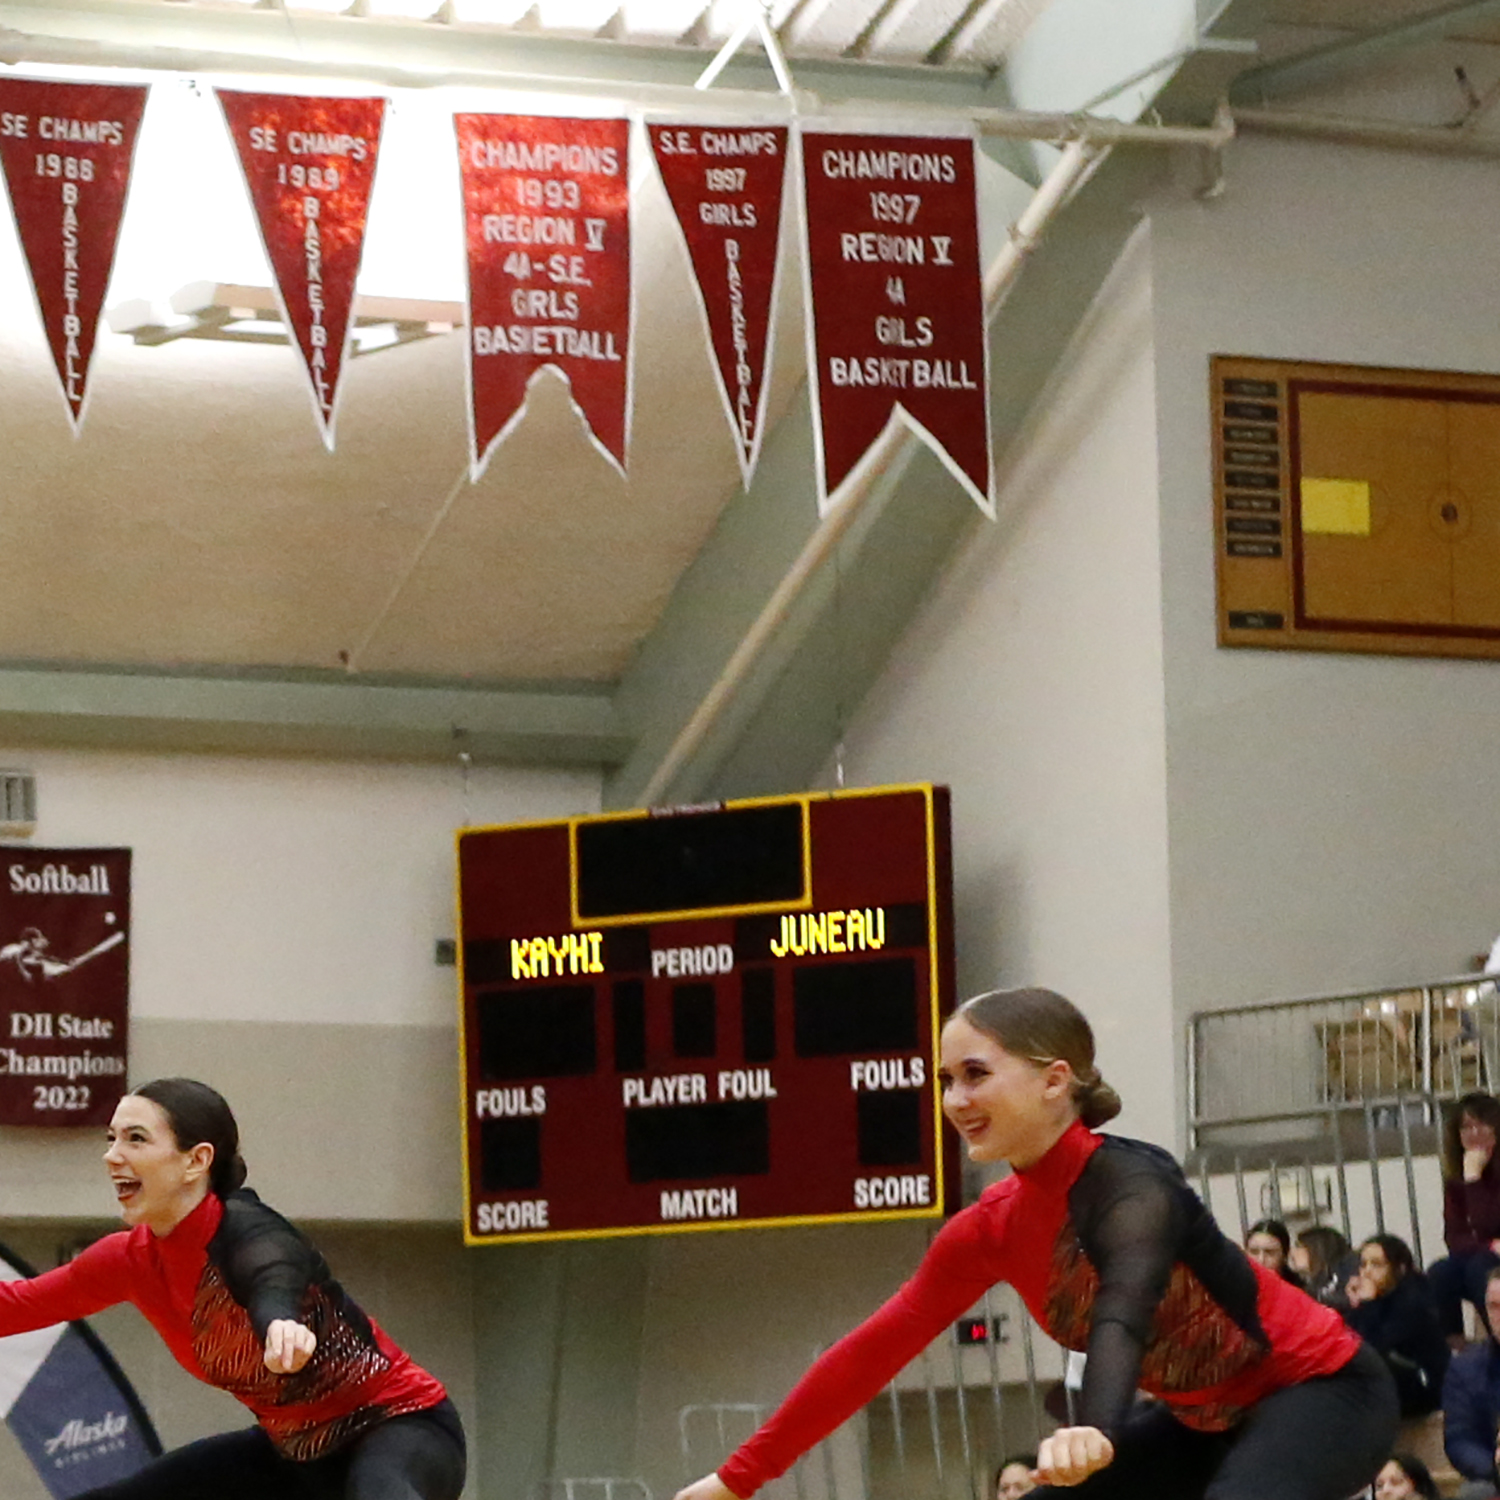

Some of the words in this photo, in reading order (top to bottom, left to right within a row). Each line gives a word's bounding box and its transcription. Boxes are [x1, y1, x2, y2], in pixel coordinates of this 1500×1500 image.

[1, 112, 28, 138] SE
[39, 116, 124, 145] CHAMPS
[249, 127, 278, 152] SE
[288, 131, 367, 161] CHAMPS
[702, 132, 777, 155] CHAMPS
[471, 140, 618, 176] CHAMPIONS
[822, 149, 955, 183] CHAMPIONS
[516, 178, 580, 209] 1993
[705, 168, 747, 192] 1997
[699, 203, 757, 227] GIRLS
[870, 192, 921, 224] 1997
[483, 214, 575, 245] REGION
[584, 218, 607, 251] V
[841, 233, 925, 263] REGION
[931, 237, 953, 266] V
[62, 183, 81, 400] BASKETBALL
[474, 324, 621, 361] BASETBALL
[8, 865, 110, 895] Softball
[771, 908, 885, 957] JUNEAU
[510, 931, 604, 979] KAYHI
[651, 944, 733, 977] PERIOD
[57, 1013, 113, 1038] State
[623, 1074, 706, 1108] PLAYER
[718, 1069, 777, 1099] FOUL
[850, 1057, 925, 1090] FOULS
[476, 1087, 546, 1117] FOULS
[660, 1188, 737, 1219] MATCH
[855, 1175, 930, 1208] SCORE
[477, 1200, 548, 1232] SCORE
[44, 1411, 128, 1455] Alaska
